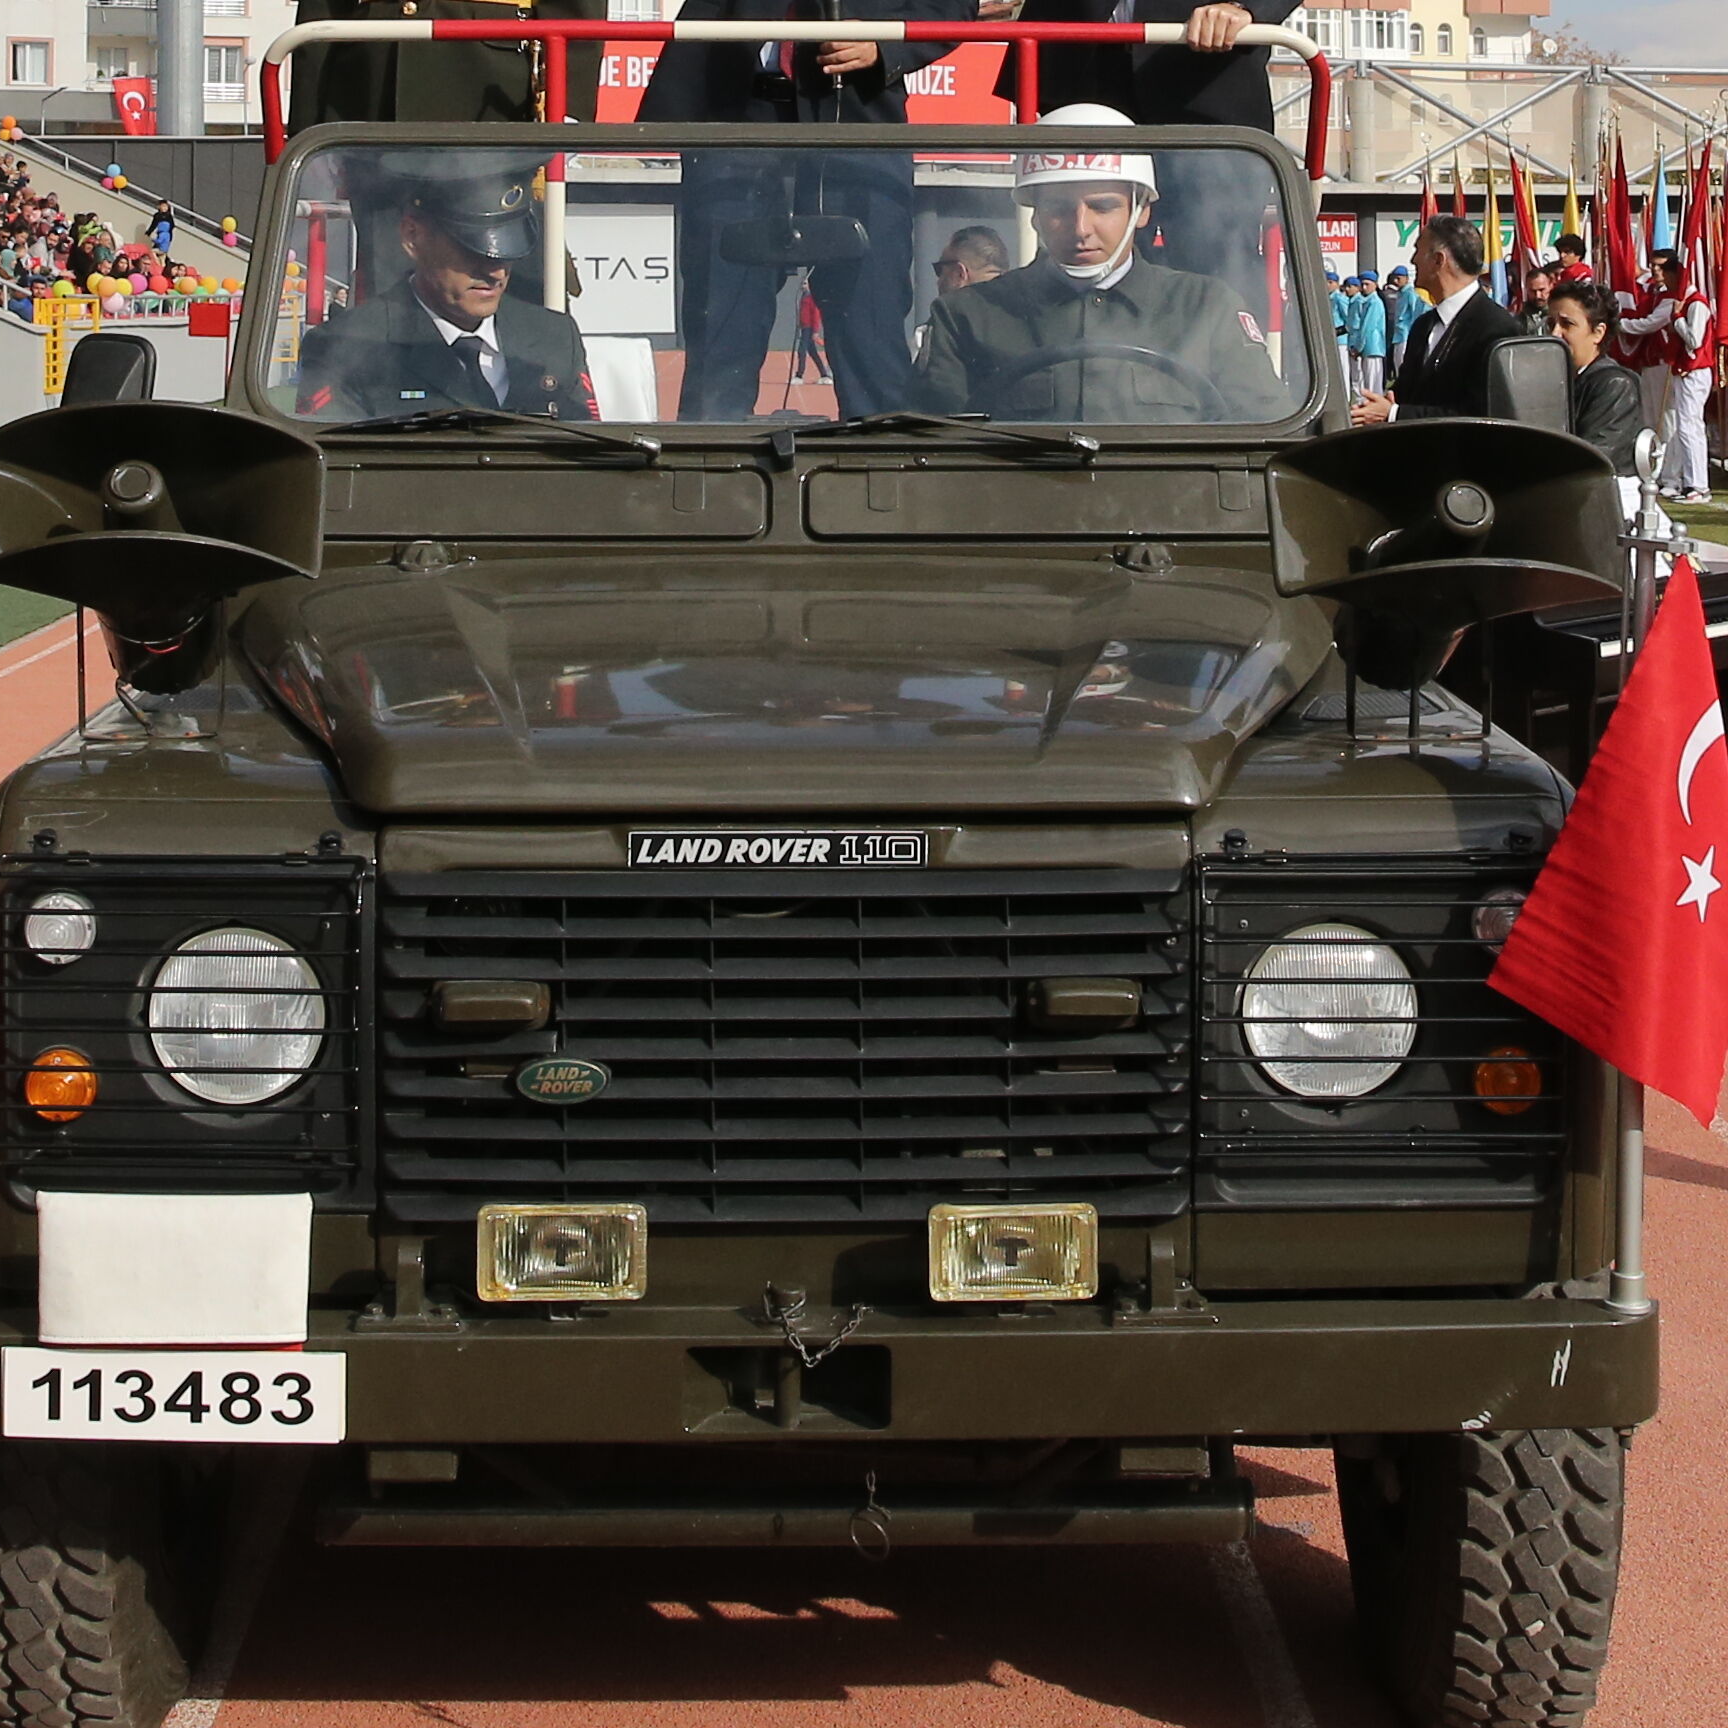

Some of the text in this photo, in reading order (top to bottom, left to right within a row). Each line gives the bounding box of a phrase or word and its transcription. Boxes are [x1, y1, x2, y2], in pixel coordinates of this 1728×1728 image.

[571, 257, 669, 283] TAŞ
[636, 835, 922, 864] LAND ROVER 110
[536, 1067, 579, 1080] LAND
[540, 1080, 593, 1094] ROVER
[31, 1367, 315, 1426] 113483
